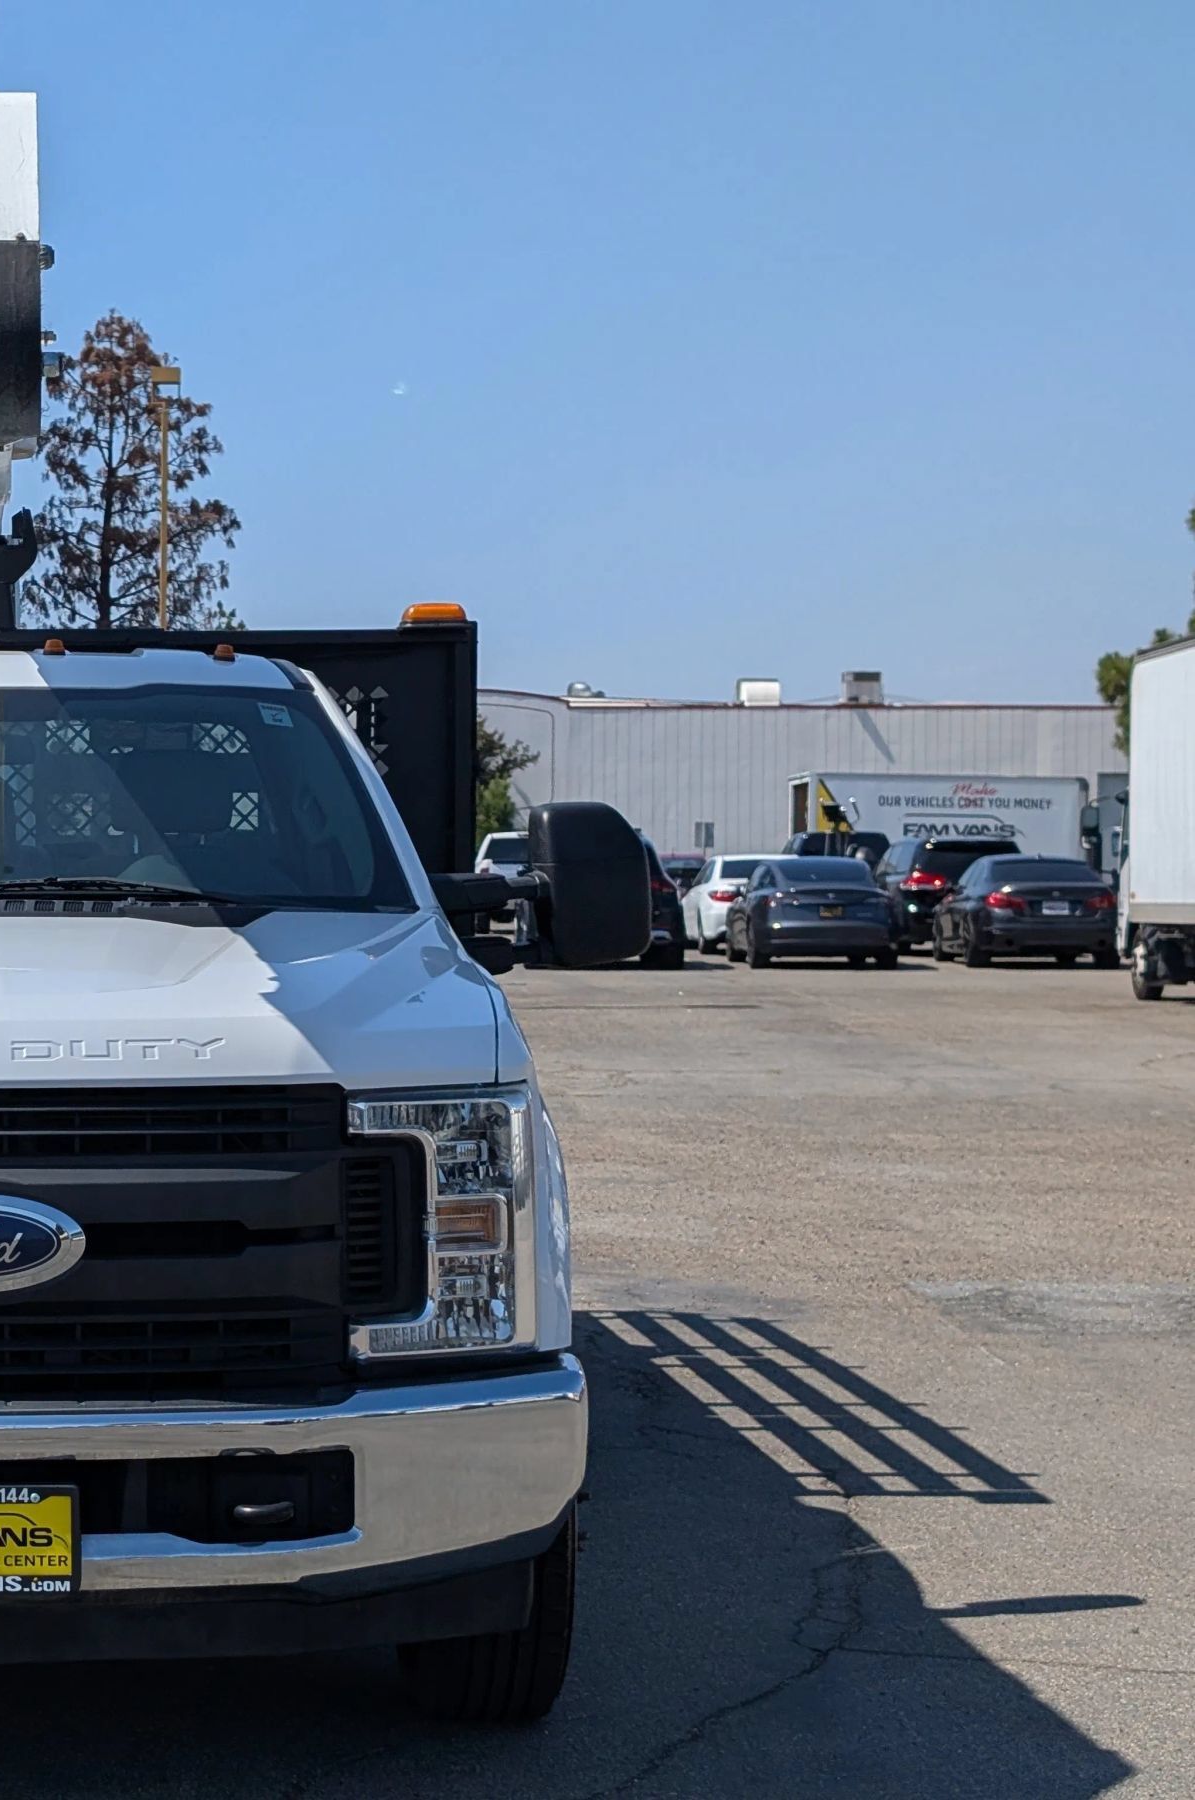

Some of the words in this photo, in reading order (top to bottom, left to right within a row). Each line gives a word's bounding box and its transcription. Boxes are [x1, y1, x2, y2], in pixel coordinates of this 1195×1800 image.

[952, 782, 997, 796] Make
[878, 795, 901, 807] OUR
[905, 795, 954, 808] VEHICLES
[957, 796, 984, 808] COST
[988, 797, 1011, 808] YOU
[1014, 798, 1051, 810] MONEY
[903, 823, 950, 838] FAM
[10, 1037, 227, 1062] DUTY
[3, 1555, 69, 1567] CENTER
